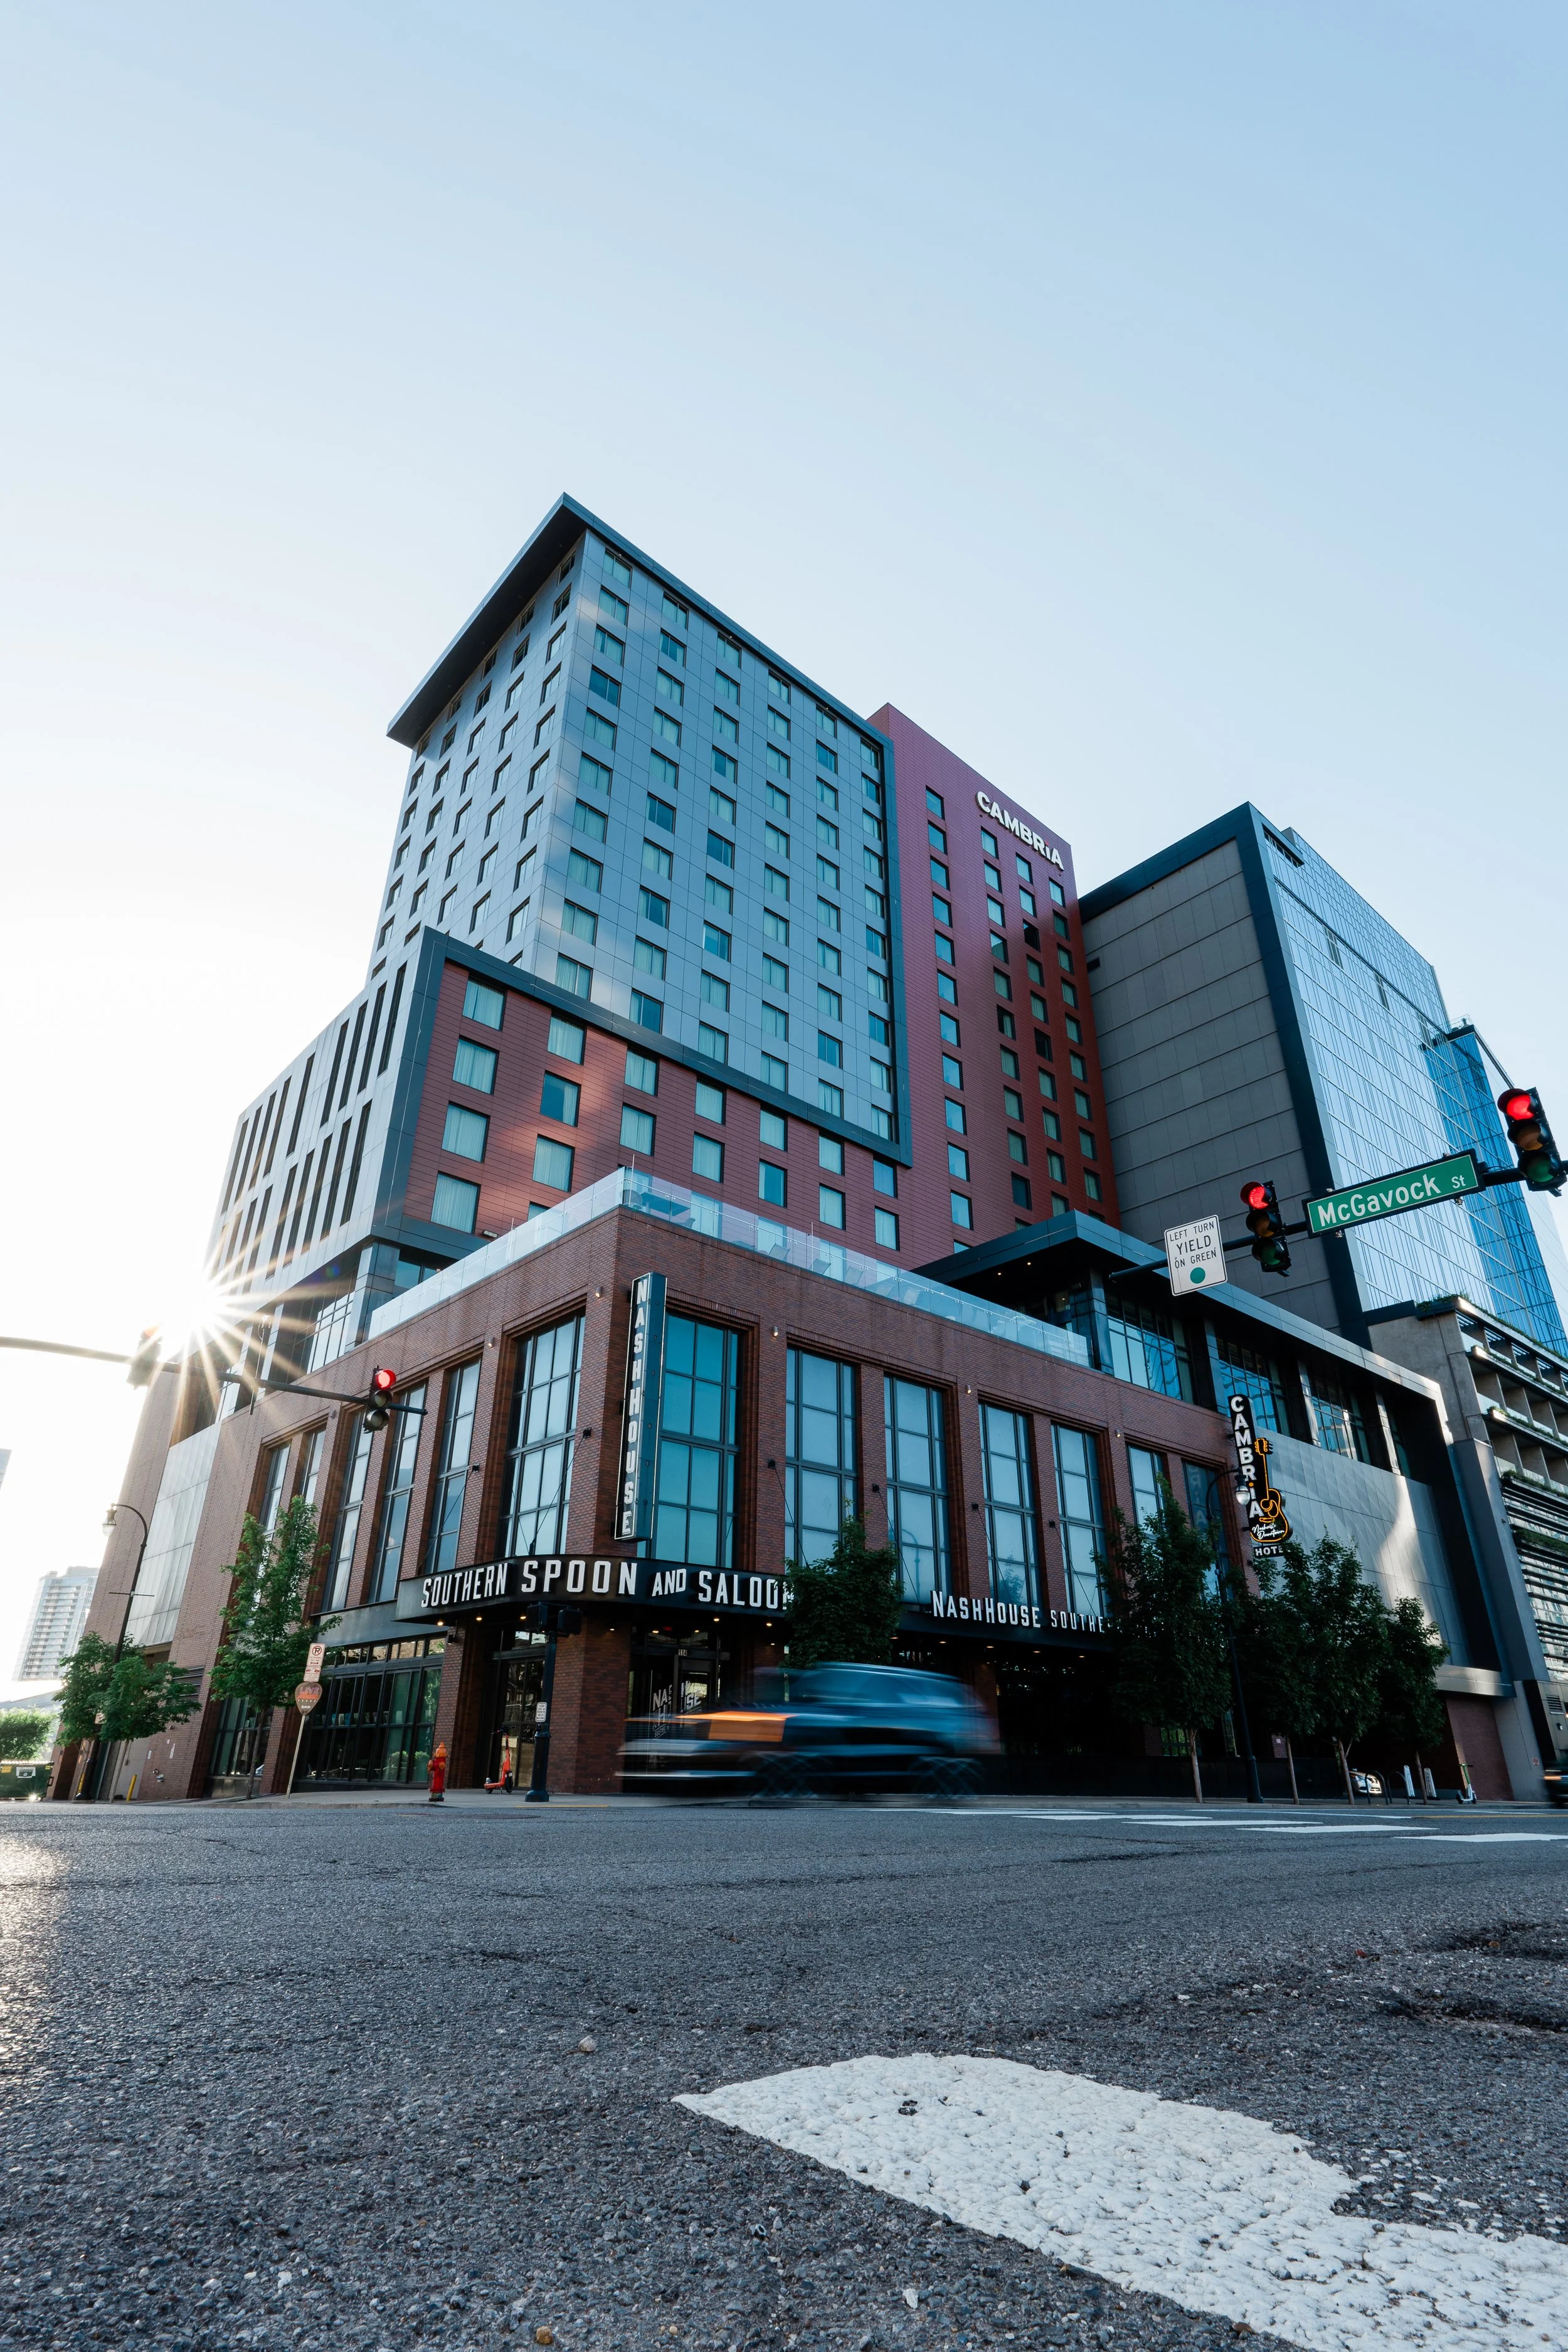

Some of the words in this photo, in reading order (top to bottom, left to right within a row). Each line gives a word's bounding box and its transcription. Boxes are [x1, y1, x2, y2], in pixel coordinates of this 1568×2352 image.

[1318, 1173, 1441, 1227] McGavock
[1451, 1175, 1466, 1189] St
[1169, 1229, 1188, 1242] LEFT
[1193, 1221, 1215, 1234] TURN
[1176, 1235, 1211, 1255] YIELD
[1175, 1258, 1185, 1269] ON
[1190, 1250, 1217, 1264] GREEN
[622, 1279, 648, 1535] NASHHOUSE
[421, 1562, 508, 1608] SOUTHERN
[521, 1560, 637, 1595] SPOON
[652, 1568, 687, 1597] AND
[932, 1591, 1041, 1628] NASHHOUSE
